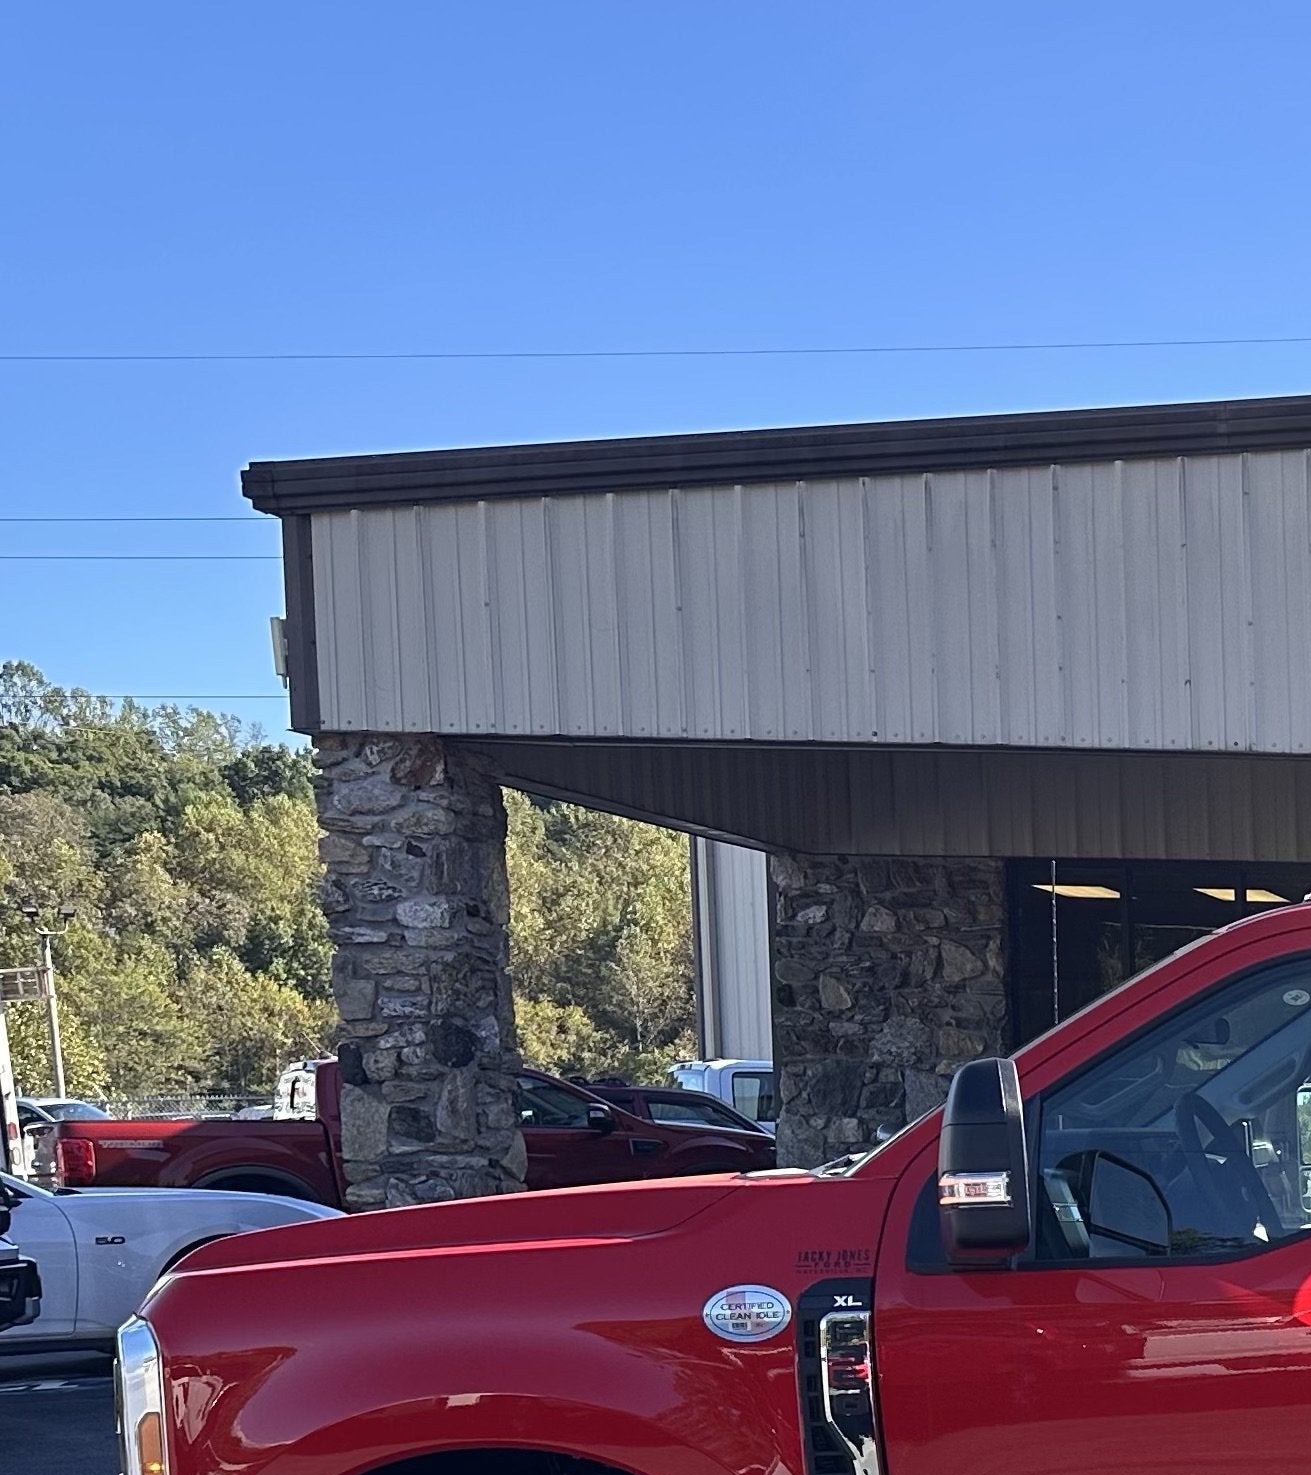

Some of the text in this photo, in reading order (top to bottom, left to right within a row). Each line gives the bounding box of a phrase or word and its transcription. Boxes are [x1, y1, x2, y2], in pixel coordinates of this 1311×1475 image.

[95, 1236, 126, 1245] 5.0
[798, 1249, 869, 1263] JACKY JONES
[720, 1302, 774, 1311] CERTIFIED
[833, 1295, 862, 1307] XL
[715, 1310, 779, 1321] CLEAN IDLE
